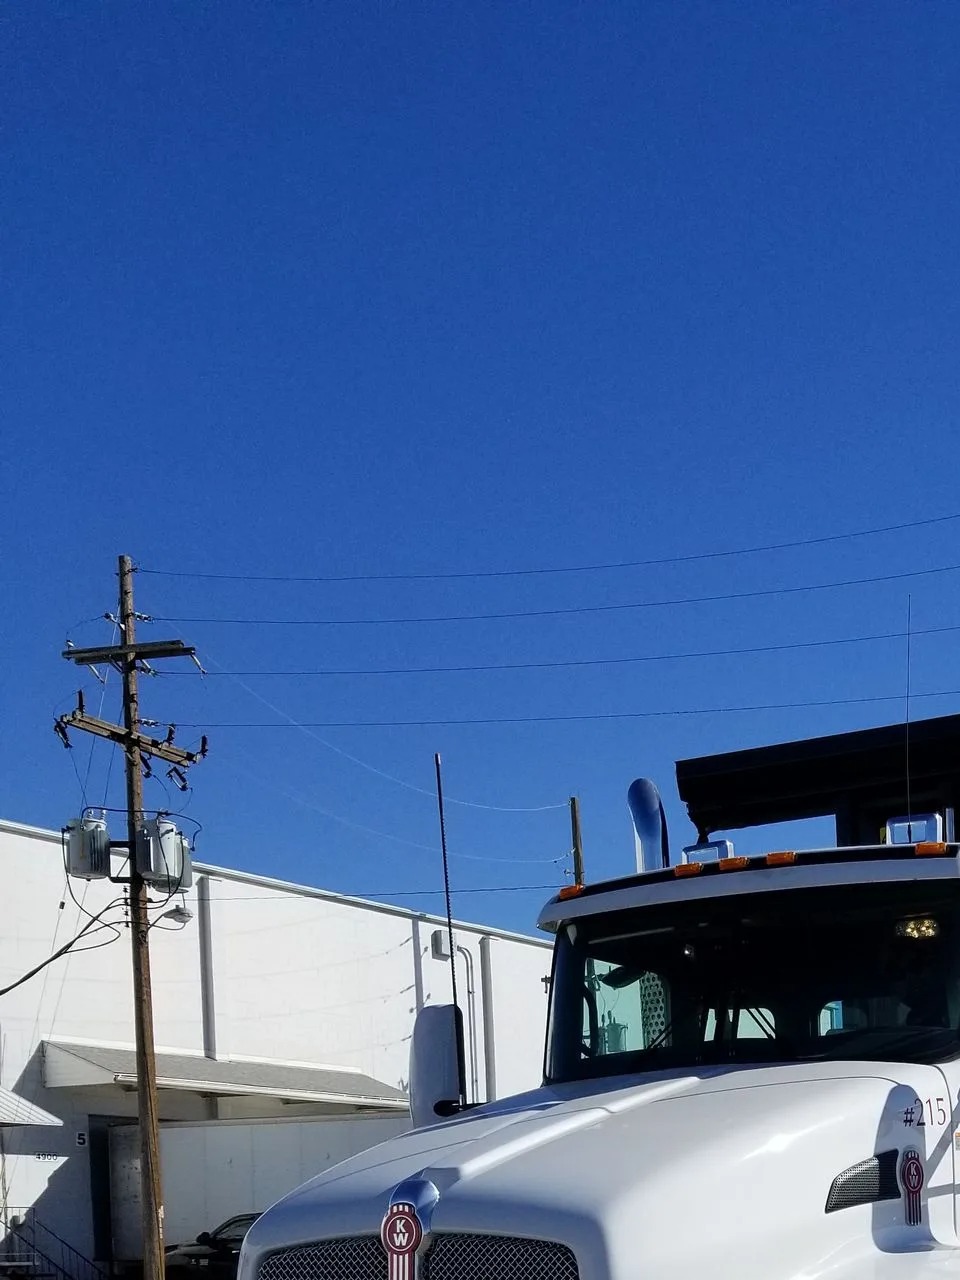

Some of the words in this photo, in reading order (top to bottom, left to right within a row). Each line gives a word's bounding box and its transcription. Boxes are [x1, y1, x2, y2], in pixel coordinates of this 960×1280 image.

[903, 1097, 947, 1127] #215
[77, 1132, 86, 1146] 5
[35, 1153, 58, 1161] 4900
